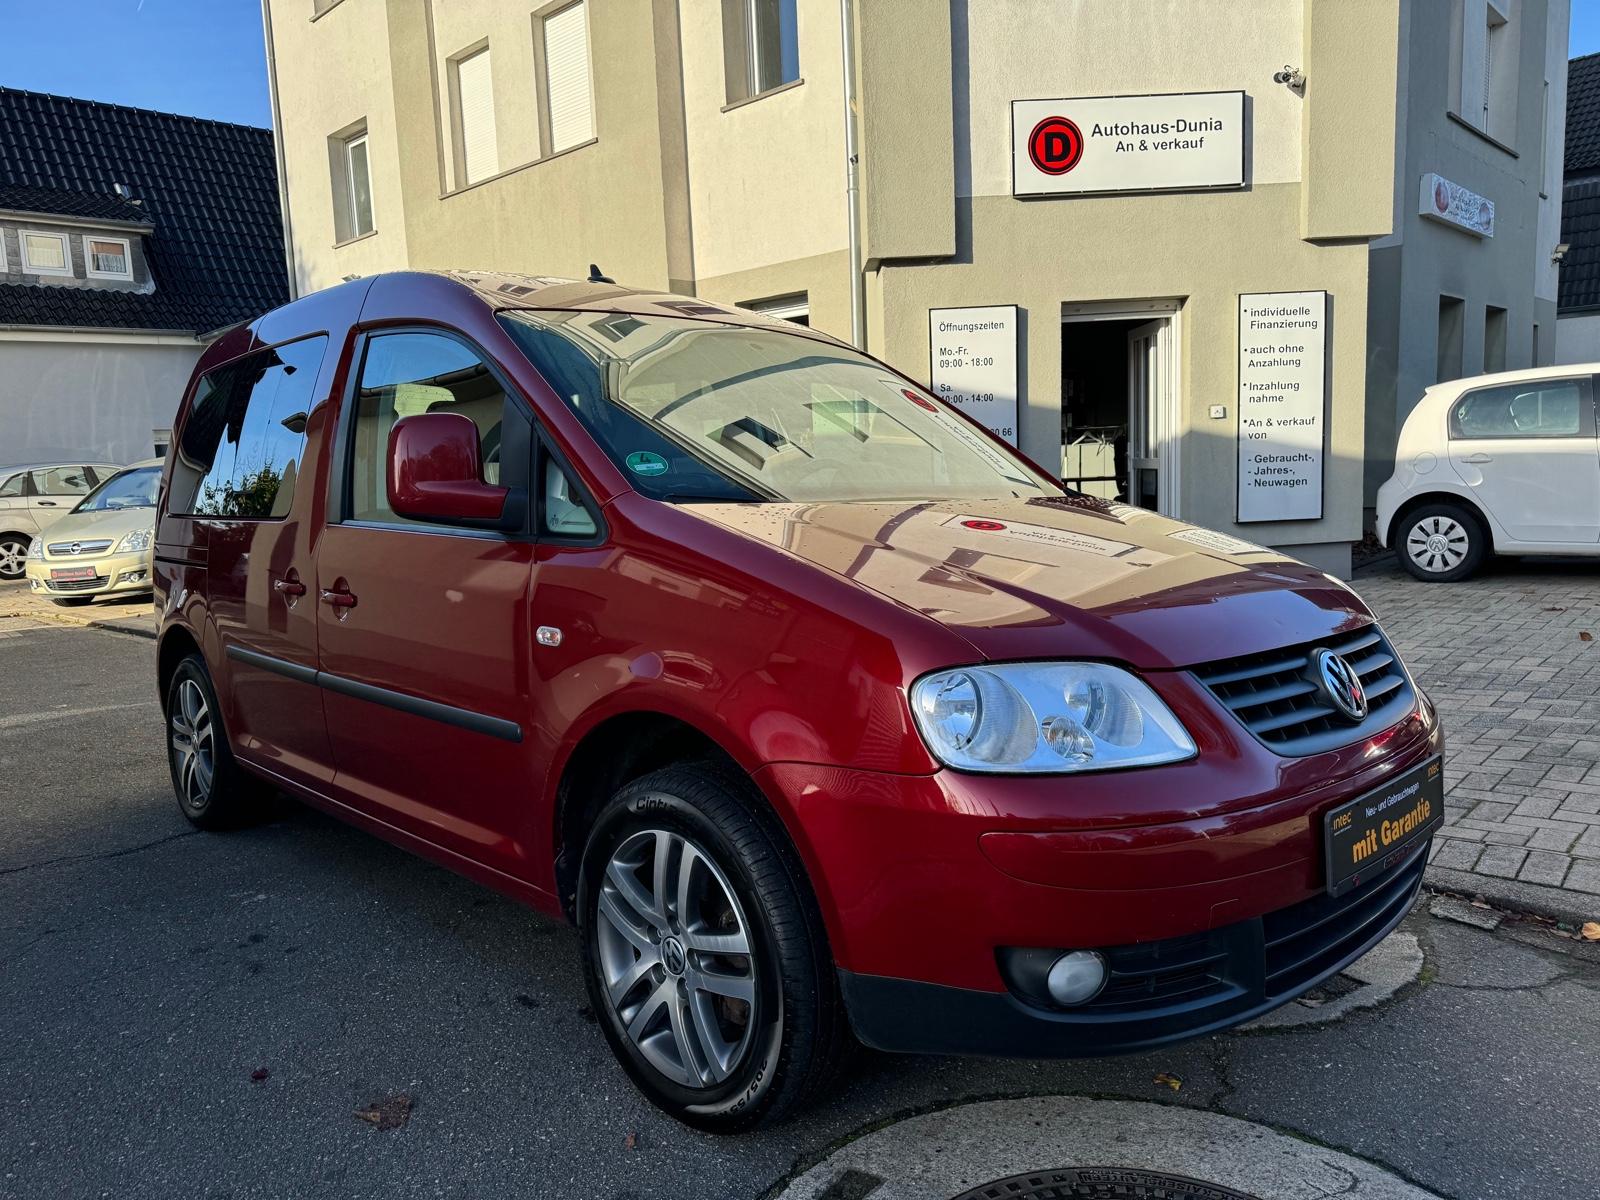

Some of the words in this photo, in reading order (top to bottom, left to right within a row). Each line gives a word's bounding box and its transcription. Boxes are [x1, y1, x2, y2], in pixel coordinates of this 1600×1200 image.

[1091, 117, 1223, 137] Autohaus-Dunia
[1044, 131, 1071, 162] D
[1115, 140, 1134, 153] An
[1138, 139, 1149, 152] &
[1152, 137, 1205, 151] verkauf
[1250, 306, 1311, 317] individuelle
[939, 321, 1005, 333] Öffnungszeiten
[1250, 319, 1318, 330] Finanzierung
[939, 346, 969, 356] Mo.-Fr.
[1249, 345, 1275, 354] auch
[1278, 344, 1305, 353] ohne
[939, 359, 963, 369] 09:00
[971, 357, 994, 367] 18:00
[1248, 358, 1301, 368] Anzahlung
[940, 383, 953, 392] Sa.
[1249, 381, 1300, 392] Inzahlung
[971, 393, 994, 402] 14:00
[1249, 394, 1284, 403] nahme
[1248, 418, 1263, 427] An
[1266, 417, 1273, 427] &
[1276, 416, 1316, 426] verkauf
[1002, 427, 1012, 437] 66
[1248, 432, 1267, 440] von
[1254, 453, 1315, 464] Gebraucht-,
[1254, 466, 1295, 476] Jahres-,
[1254, 478, 1308, 488] Neuwagen
[1377, 798, 1387, 812] und
[1387, 781, 1420, 807] Gebrauchtwagen
[1352, 828, 1378, 864] mit
[1380, 797, 1431, 847] Garantie
